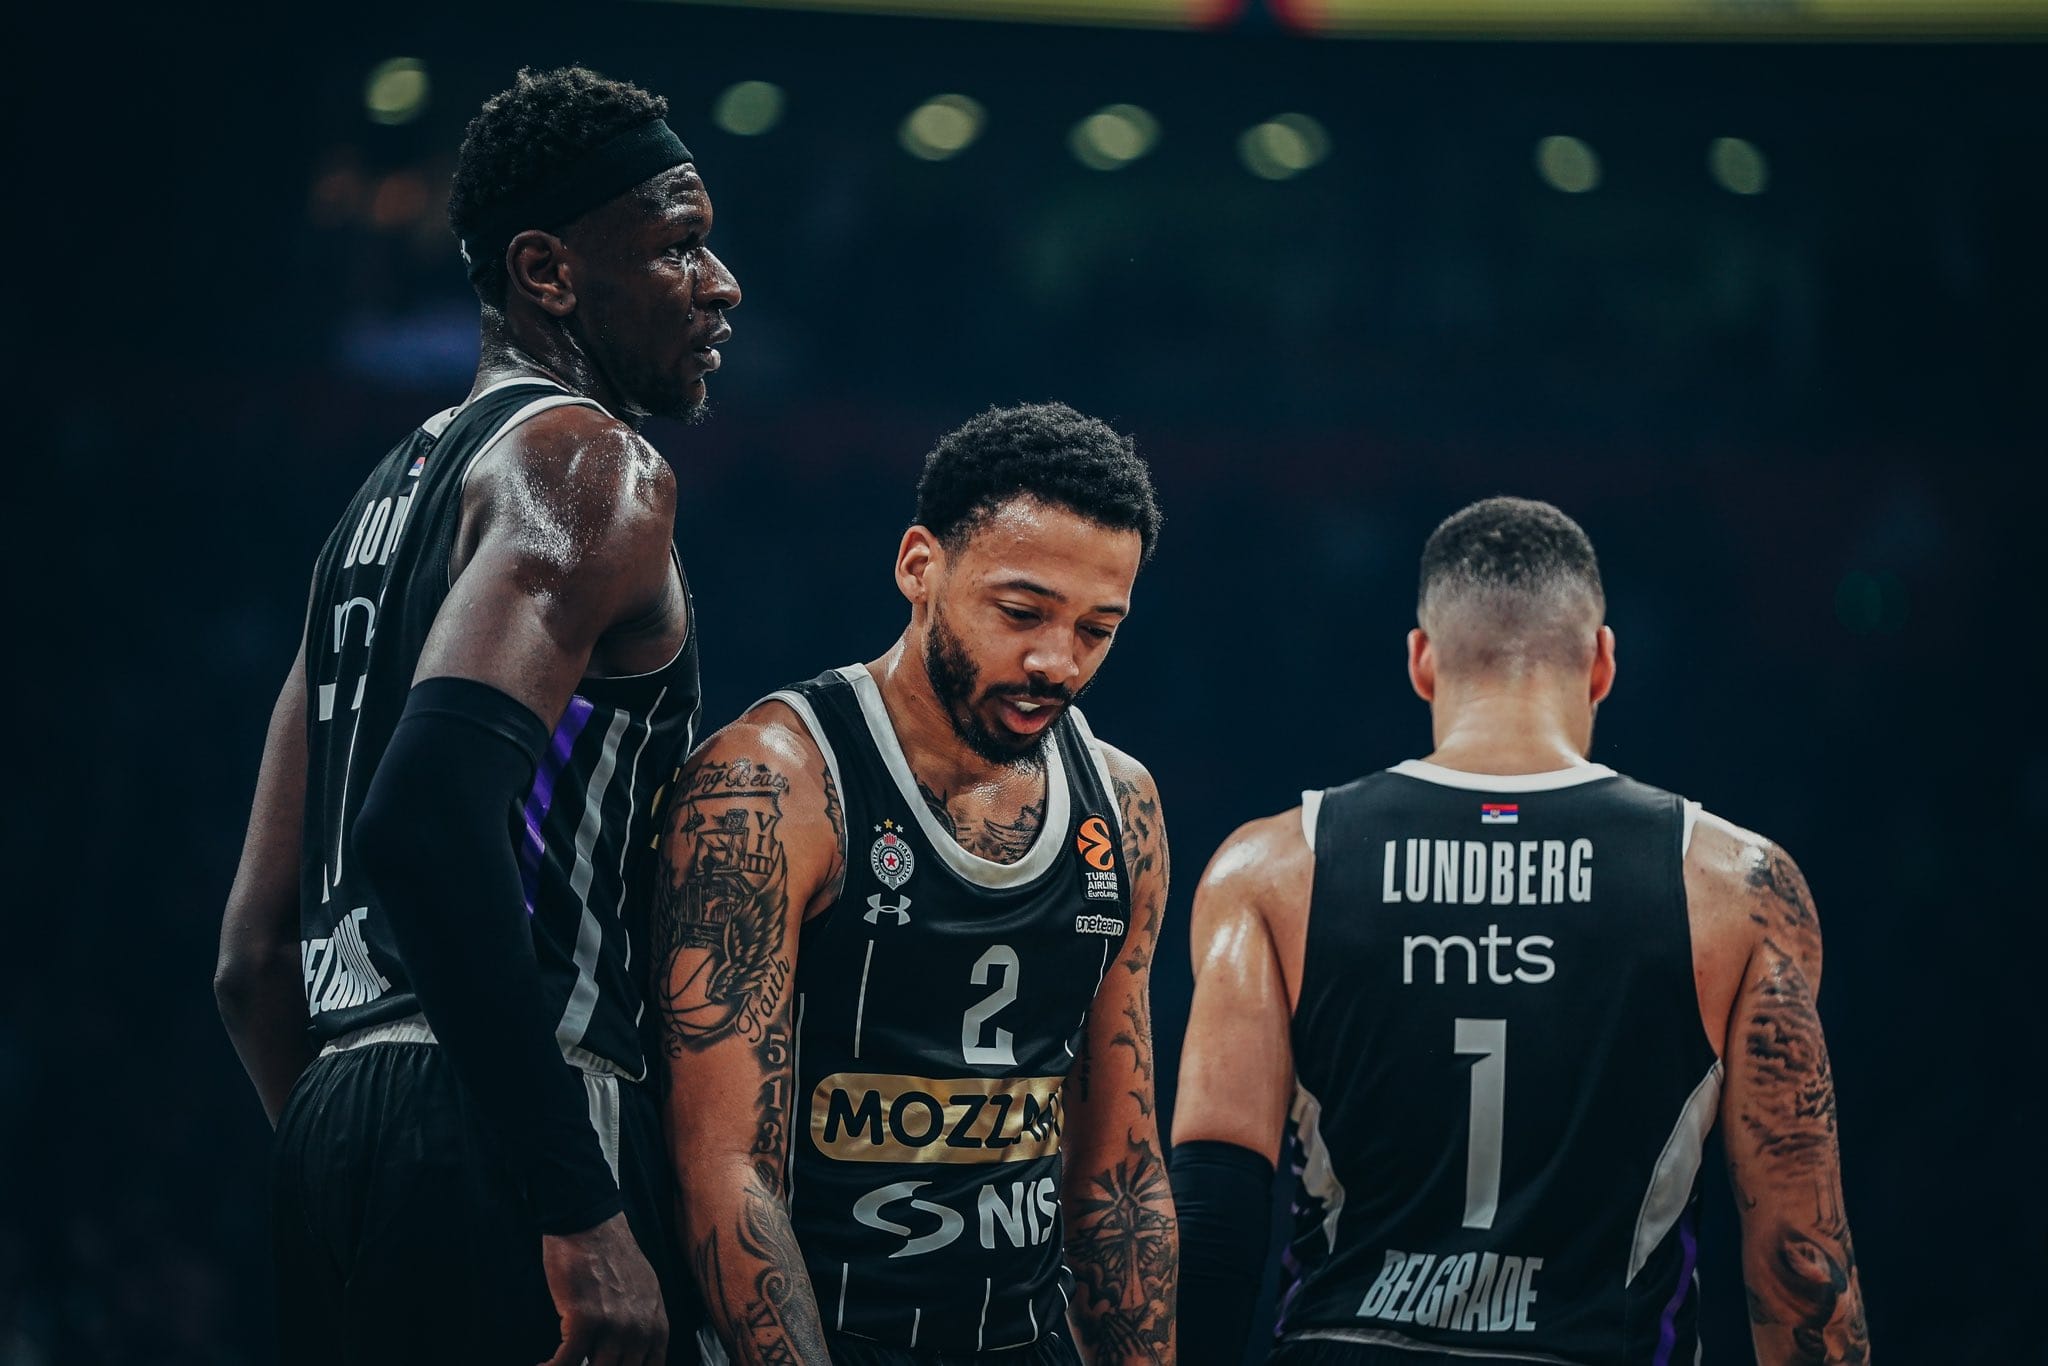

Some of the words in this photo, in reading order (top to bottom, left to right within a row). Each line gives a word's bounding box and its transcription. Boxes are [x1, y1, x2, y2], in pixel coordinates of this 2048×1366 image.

[1382, 838, 1592, 905] LUNDBERG
[1077, 915, 1123, 935] oneteam
[1403, 924, 1555, 984] mts
[736, 954, 790, 1043] Faith
[962, 944, 1020, 1066] 2
[1454, 1018, 1507, 1229] 1
[977, 1177, 1057, 1249] NIS
[1356, 1250, 1544, 1332] BELGRADE
